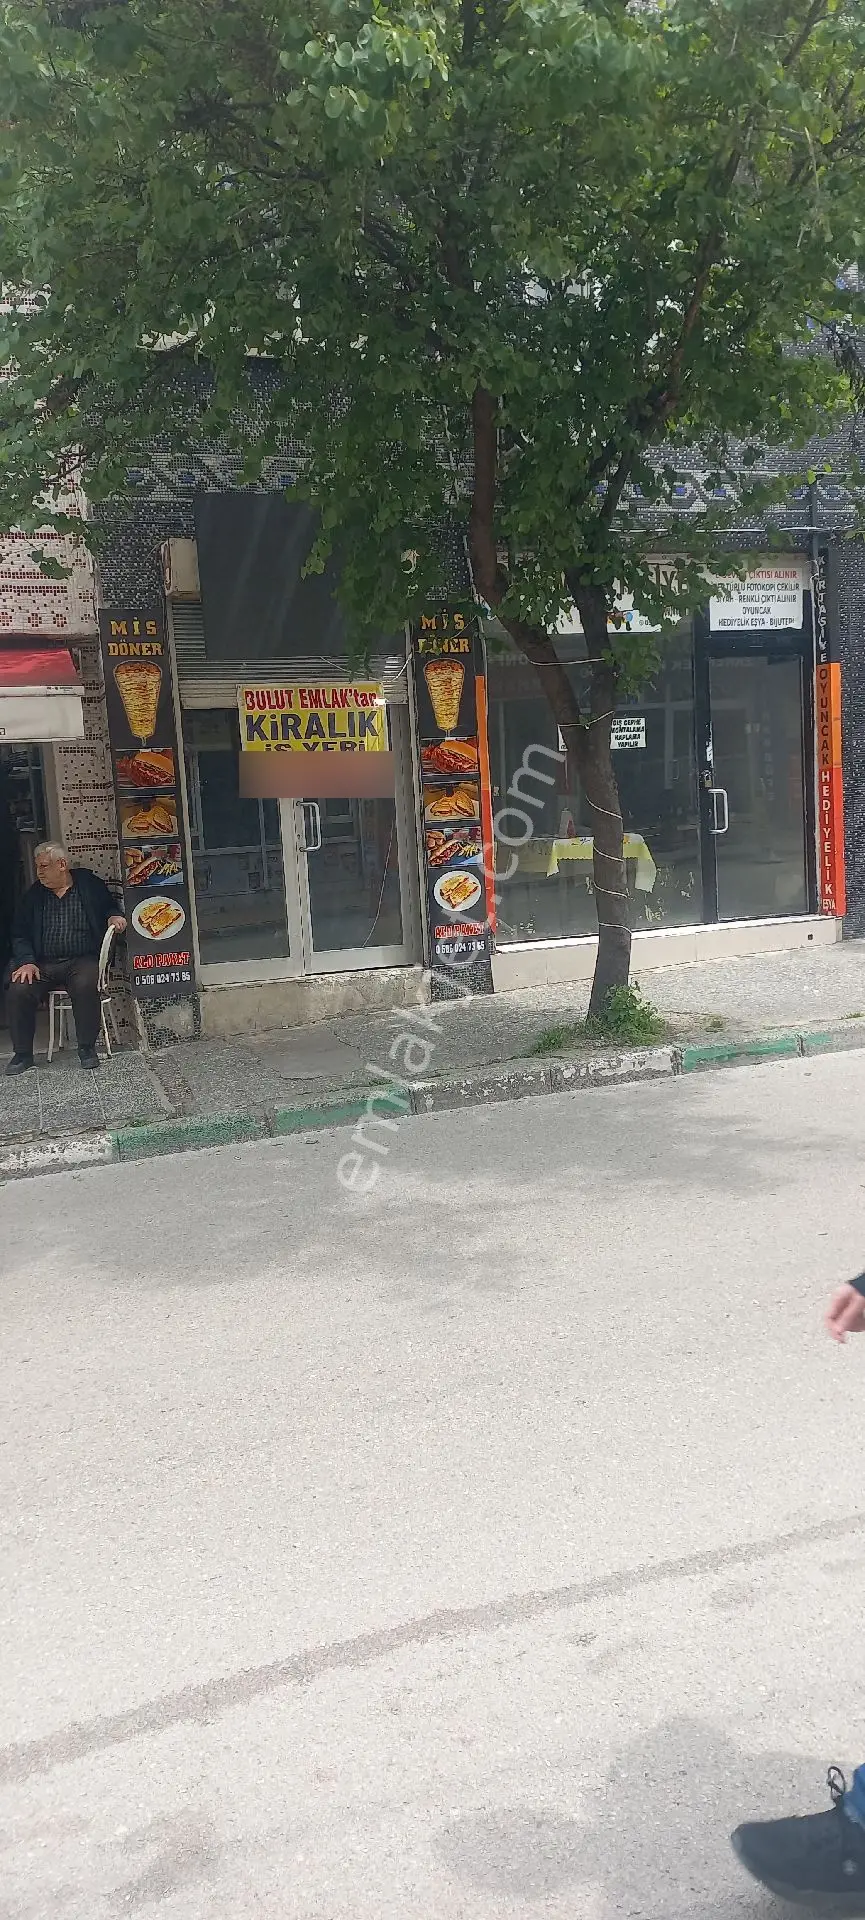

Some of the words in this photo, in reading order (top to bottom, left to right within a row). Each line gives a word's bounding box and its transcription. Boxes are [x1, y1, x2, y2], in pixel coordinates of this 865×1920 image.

[774, 570, 798, 579] ALINIR
[738, 593, 760, 603] RENKLİ
[776, 594, 797, 603] ALINIR
[742, 606, 772, 615] OYUNCAK
[110, 616, 158, 636] MİS
[750, 617, 766, 628] EŞYA
[107, 638, 165, 656] DÖNER
[244, 688, 294, 711] BULUT
[819, 668, 829, 767] OYUNCAK
[614, 733, 641, 741] KAPLAMA
[435, 925, 453, 939] ALO
[133, 954, 154, 970] ALO
[154, 951, 191, 968] PAKET
